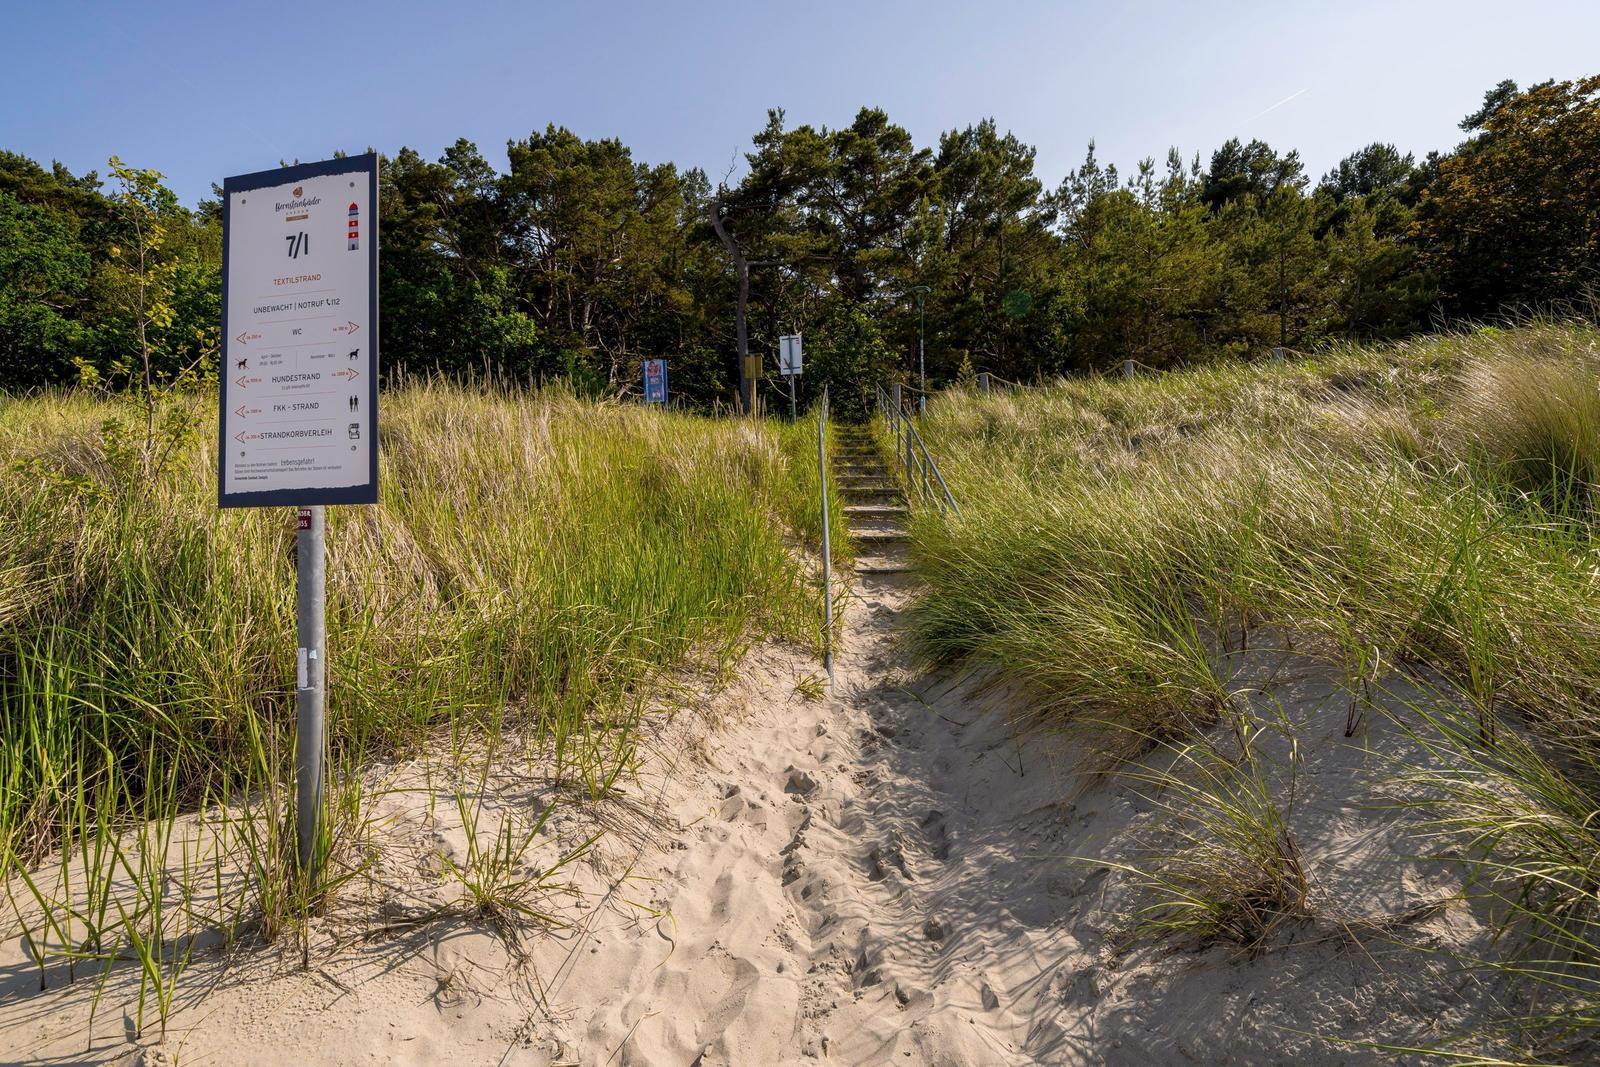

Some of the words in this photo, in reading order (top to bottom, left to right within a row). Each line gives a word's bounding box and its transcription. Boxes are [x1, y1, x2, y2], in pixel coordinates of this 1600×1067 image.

[275, 196, 321, 212] Bernsteinbäder
[273, 274, 321, 286] TEXTILSTRAND
[253, 303, 293, 314] UNBEWACHT
[298, 300, 324, 310] NOTRUF
[331, 298, 341, 306] 112
[292, 328, 302, 336] WC
[272, 373, 321, 384] HUNDESTRAND
[273, 404, 286, 412] FKK
[292, 402, 320, 411] STRAND
[260, 429, 332, 440] STRANDKORBVERLEIH
